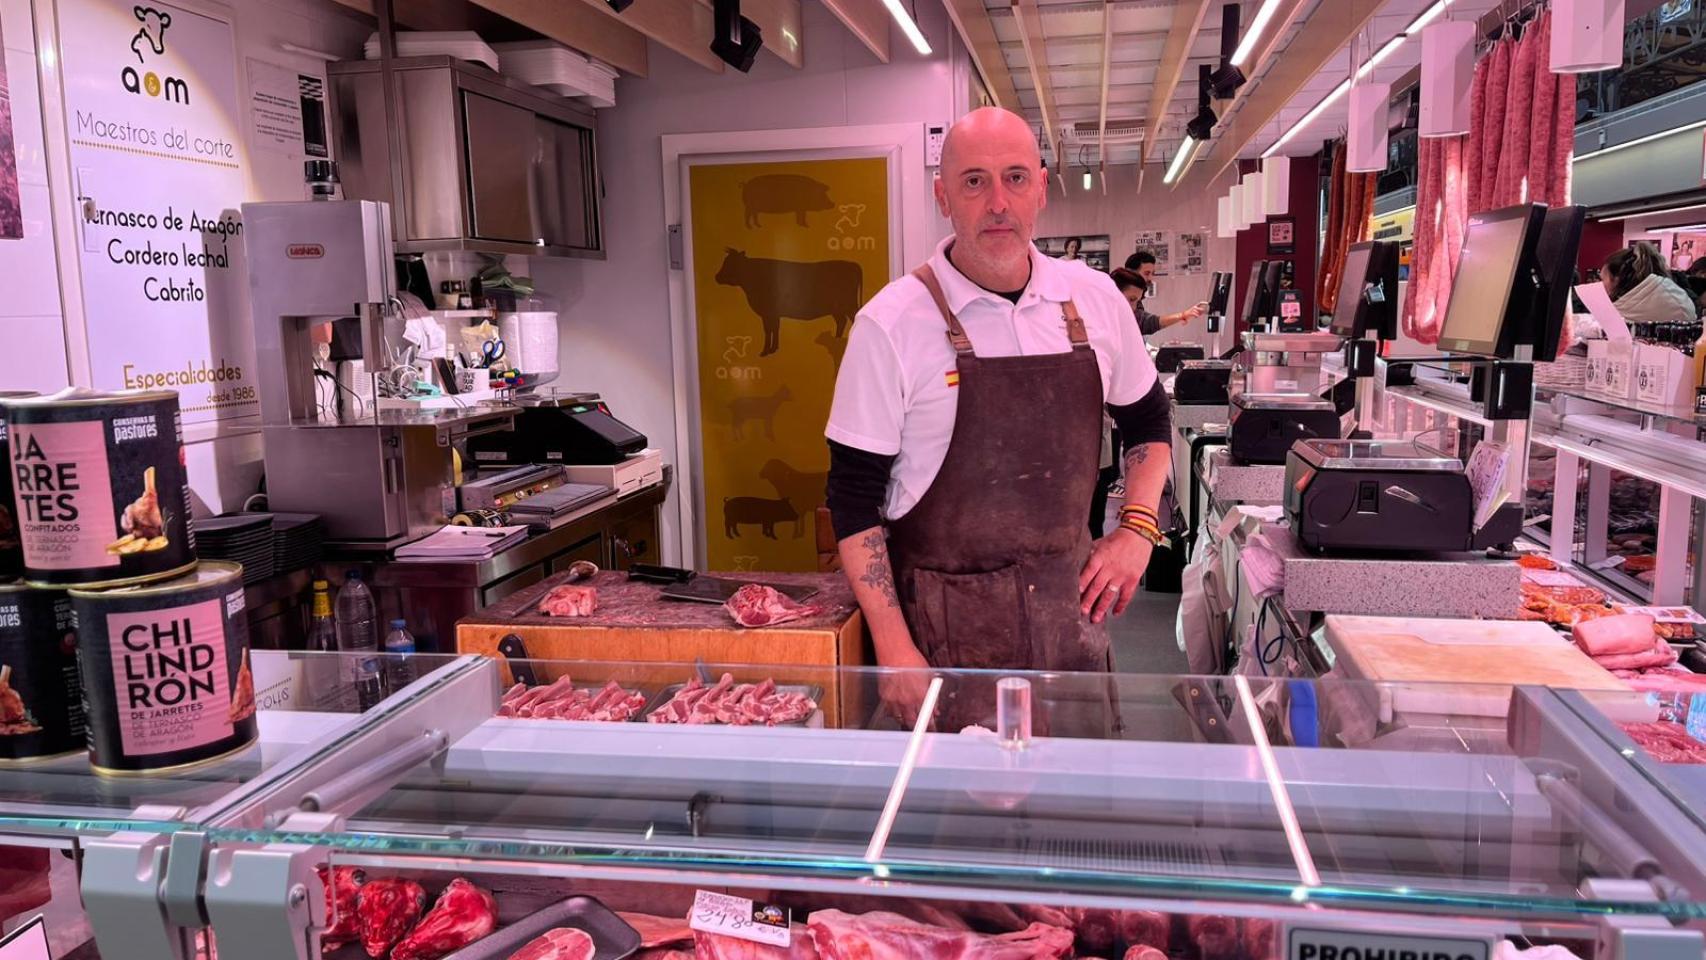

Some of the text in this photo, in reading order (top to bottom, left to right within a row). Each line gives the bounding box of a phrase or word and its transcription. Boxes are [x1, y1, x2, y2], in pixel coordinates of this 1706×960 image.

[76, 109, 234, 159] Maestros del corte
[86, 206, 243, 244] ernasco de Aragón
[107, 238, 230, 269] Cordero lechal
[143, 276, 205, 302] Cabrito
[123, 357, 242, 390] Especialidades
[13, 432, 46, 461] JA
[113, 423, 158, 446] pastores
[17, 462, 80, 493] RRE
[21, 493, 79, 522] TES
[122, 617, 193, 652] CHI
[123, 643, 215, 681] LIND
[129, 671, 216, 710] RÓN
[130, 702, 204, 720] DE JARRETES
